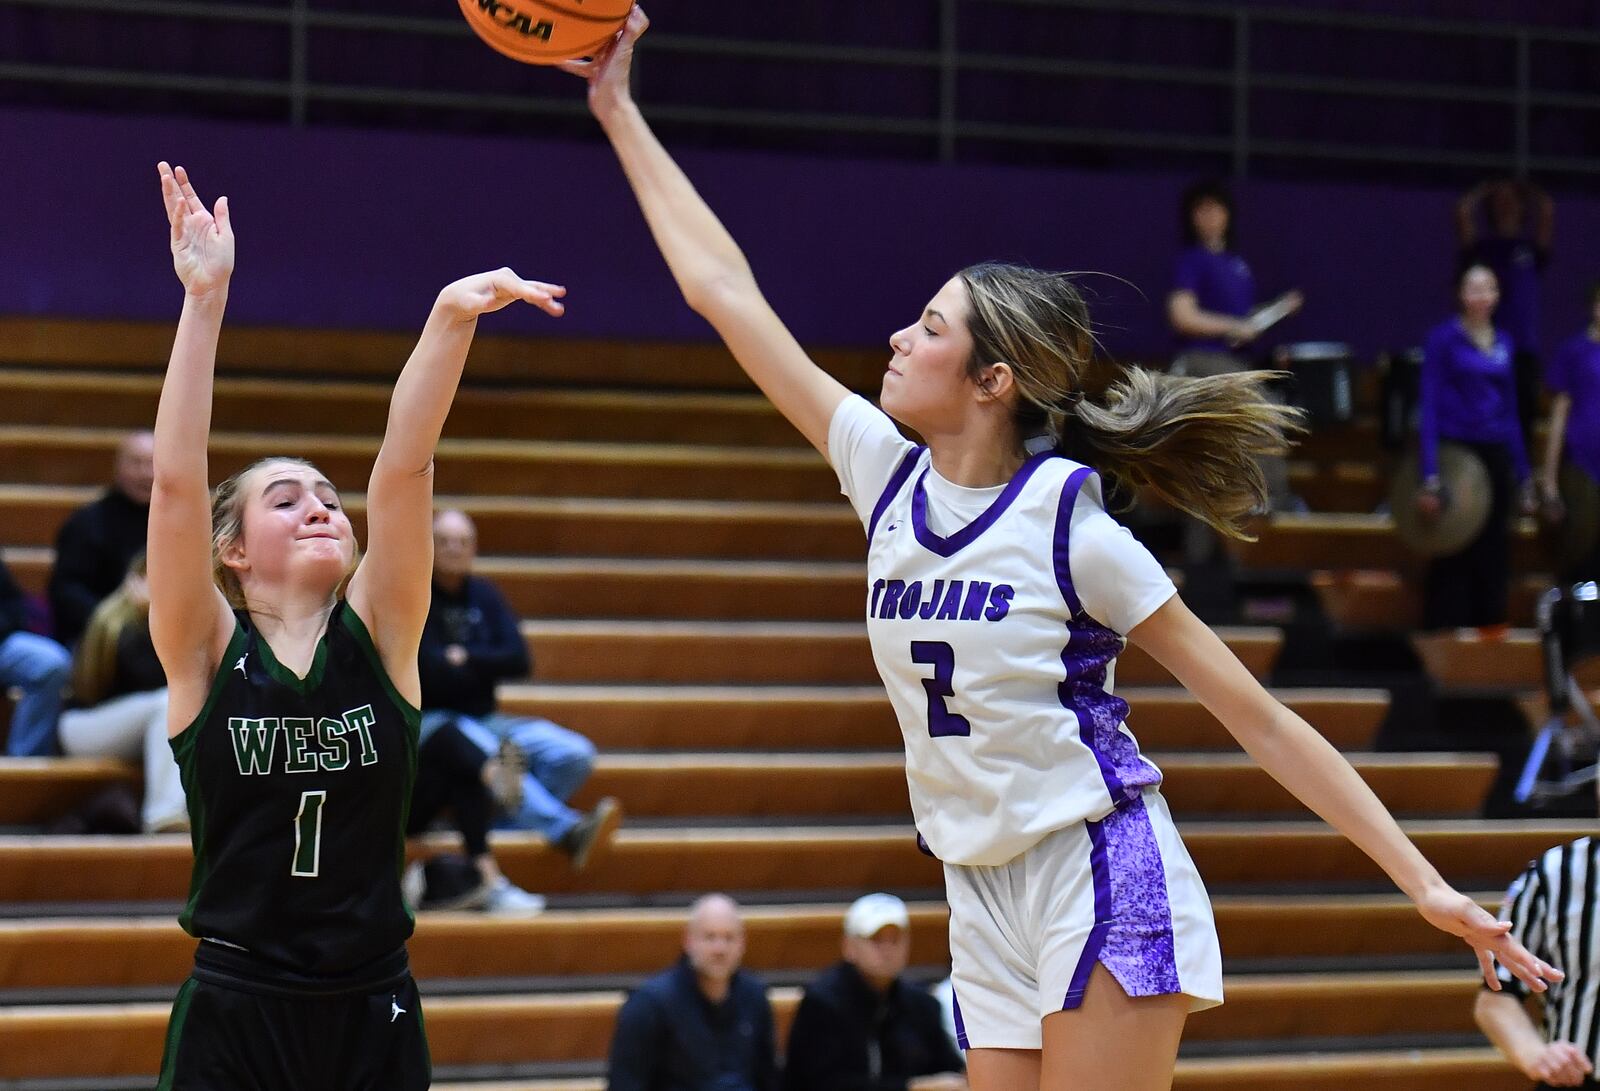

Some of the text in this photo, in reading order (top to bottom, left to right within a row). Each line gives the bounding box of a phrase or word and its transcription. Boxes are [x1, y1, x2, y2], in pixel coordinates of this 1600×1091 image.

[870, 578, 1016, 622] TROJANS
[910, 640, 971, 738] 2
[228, 704, 378, 775] WEST
[291, 790, 327, 877] 1
